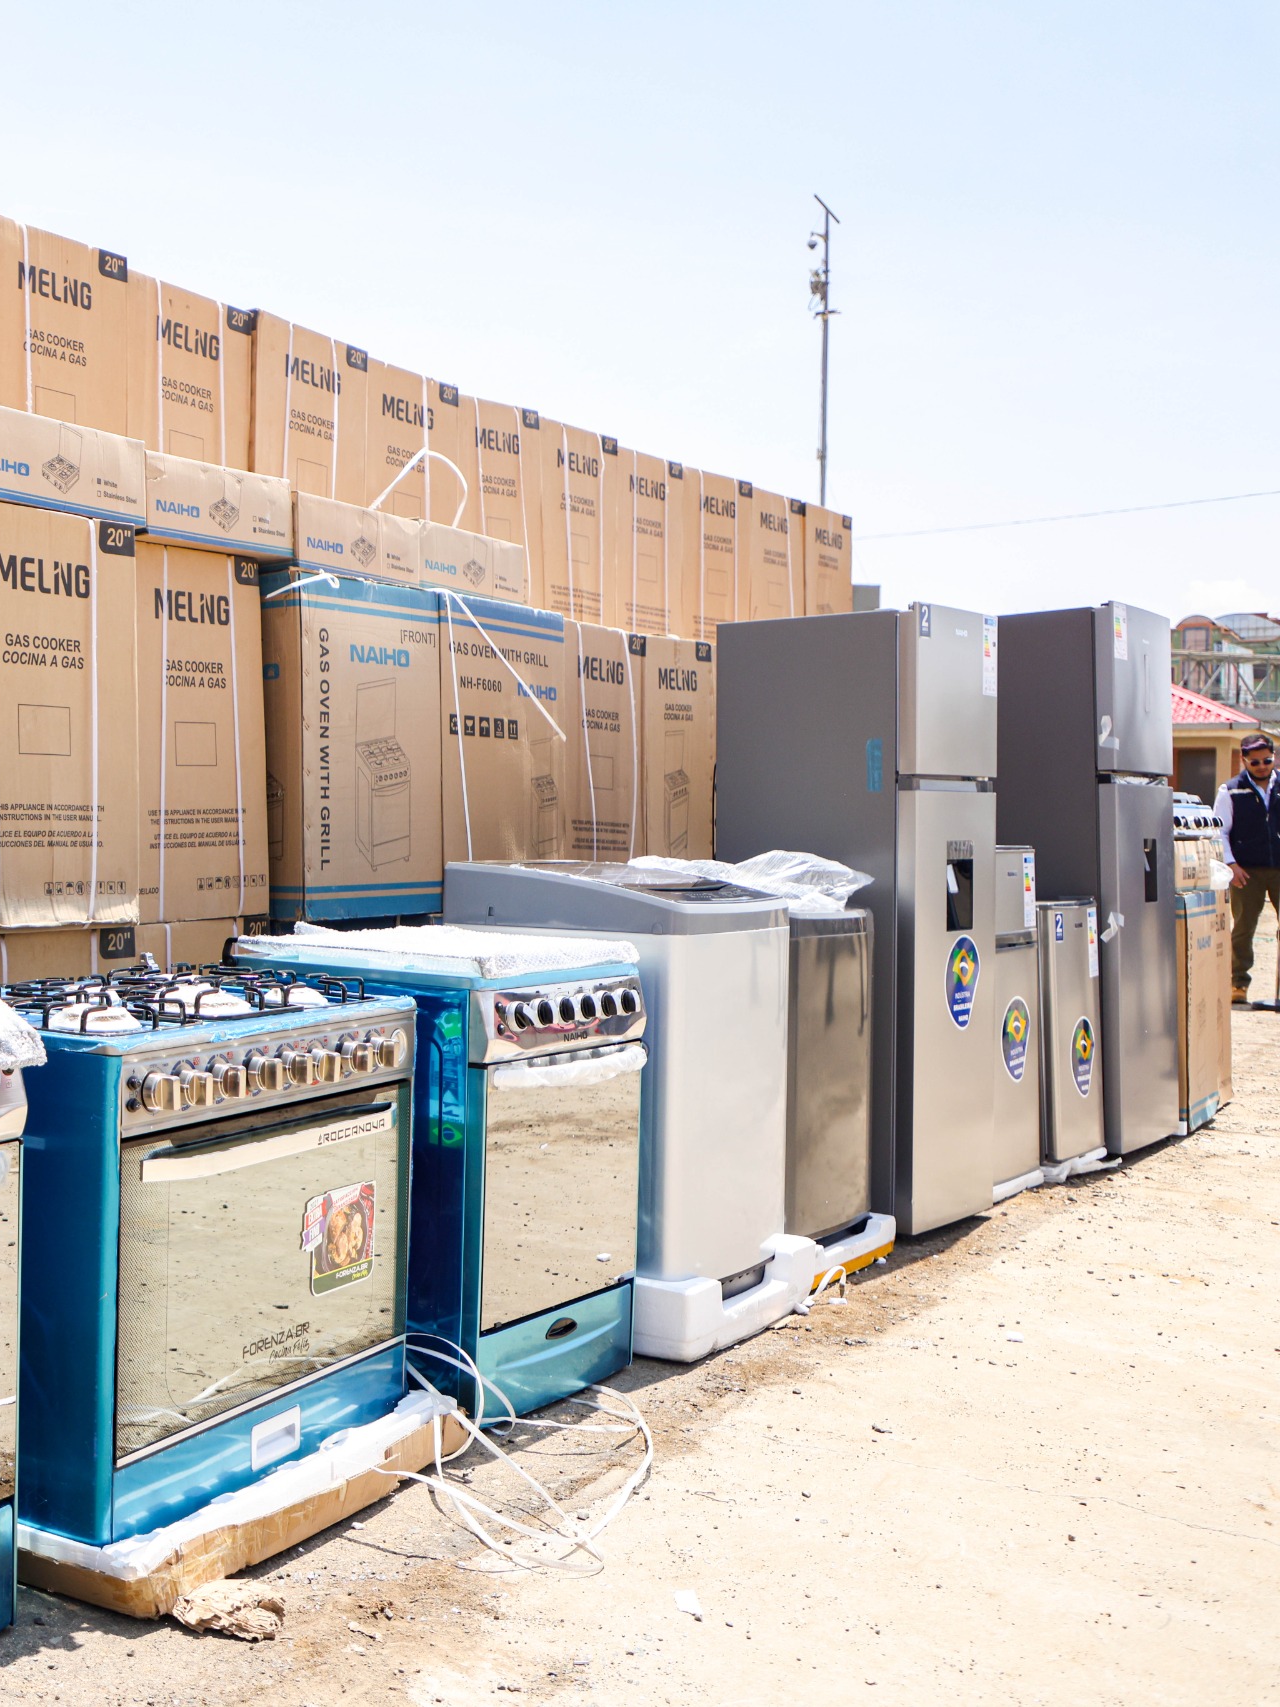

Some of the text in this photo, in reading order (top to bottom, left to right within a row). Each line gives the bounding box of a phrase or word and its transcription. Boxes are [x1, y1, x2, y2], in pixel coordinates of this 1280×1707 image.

[104, 255, 125, 273] 20"
[231, 310, 249, 327] 20"
[47, 333, 85, 353] COOKER
[68, 353, 87, 367] GAS
[350, 349, 366, 364] 20"
[161, 376, 212, 400] GAS COOKER
[288, 420, 315, 435] COCINA
[290, 408, 335, 430] GAS COOKER
[156, 499, 200, 519] NAIHO
[107, 528, 131, 547] 20"
[307, 537, 344, 554] NAIHO
[425, 559, 457, 576] NAIHO
[921, 605, 929, 627] 2
[5, 633, 81, 652] GAS COOKER
[400, 629, 436, 647] [FRONT]
[2, 651, 84, 670] COCINA A GAS
[349, 644, 410, 667] NAIHO
[471, 642, 497, 659] OVEN
[523, 651, 549, 668] GRILL
[185, 660, 224, 674] COOKER
[460, 675, 502, 693] NH-F6060
[319, 628, 331, 870] GAS OVEN WITH GRILL
[108, 932, 131, 951] 20"
